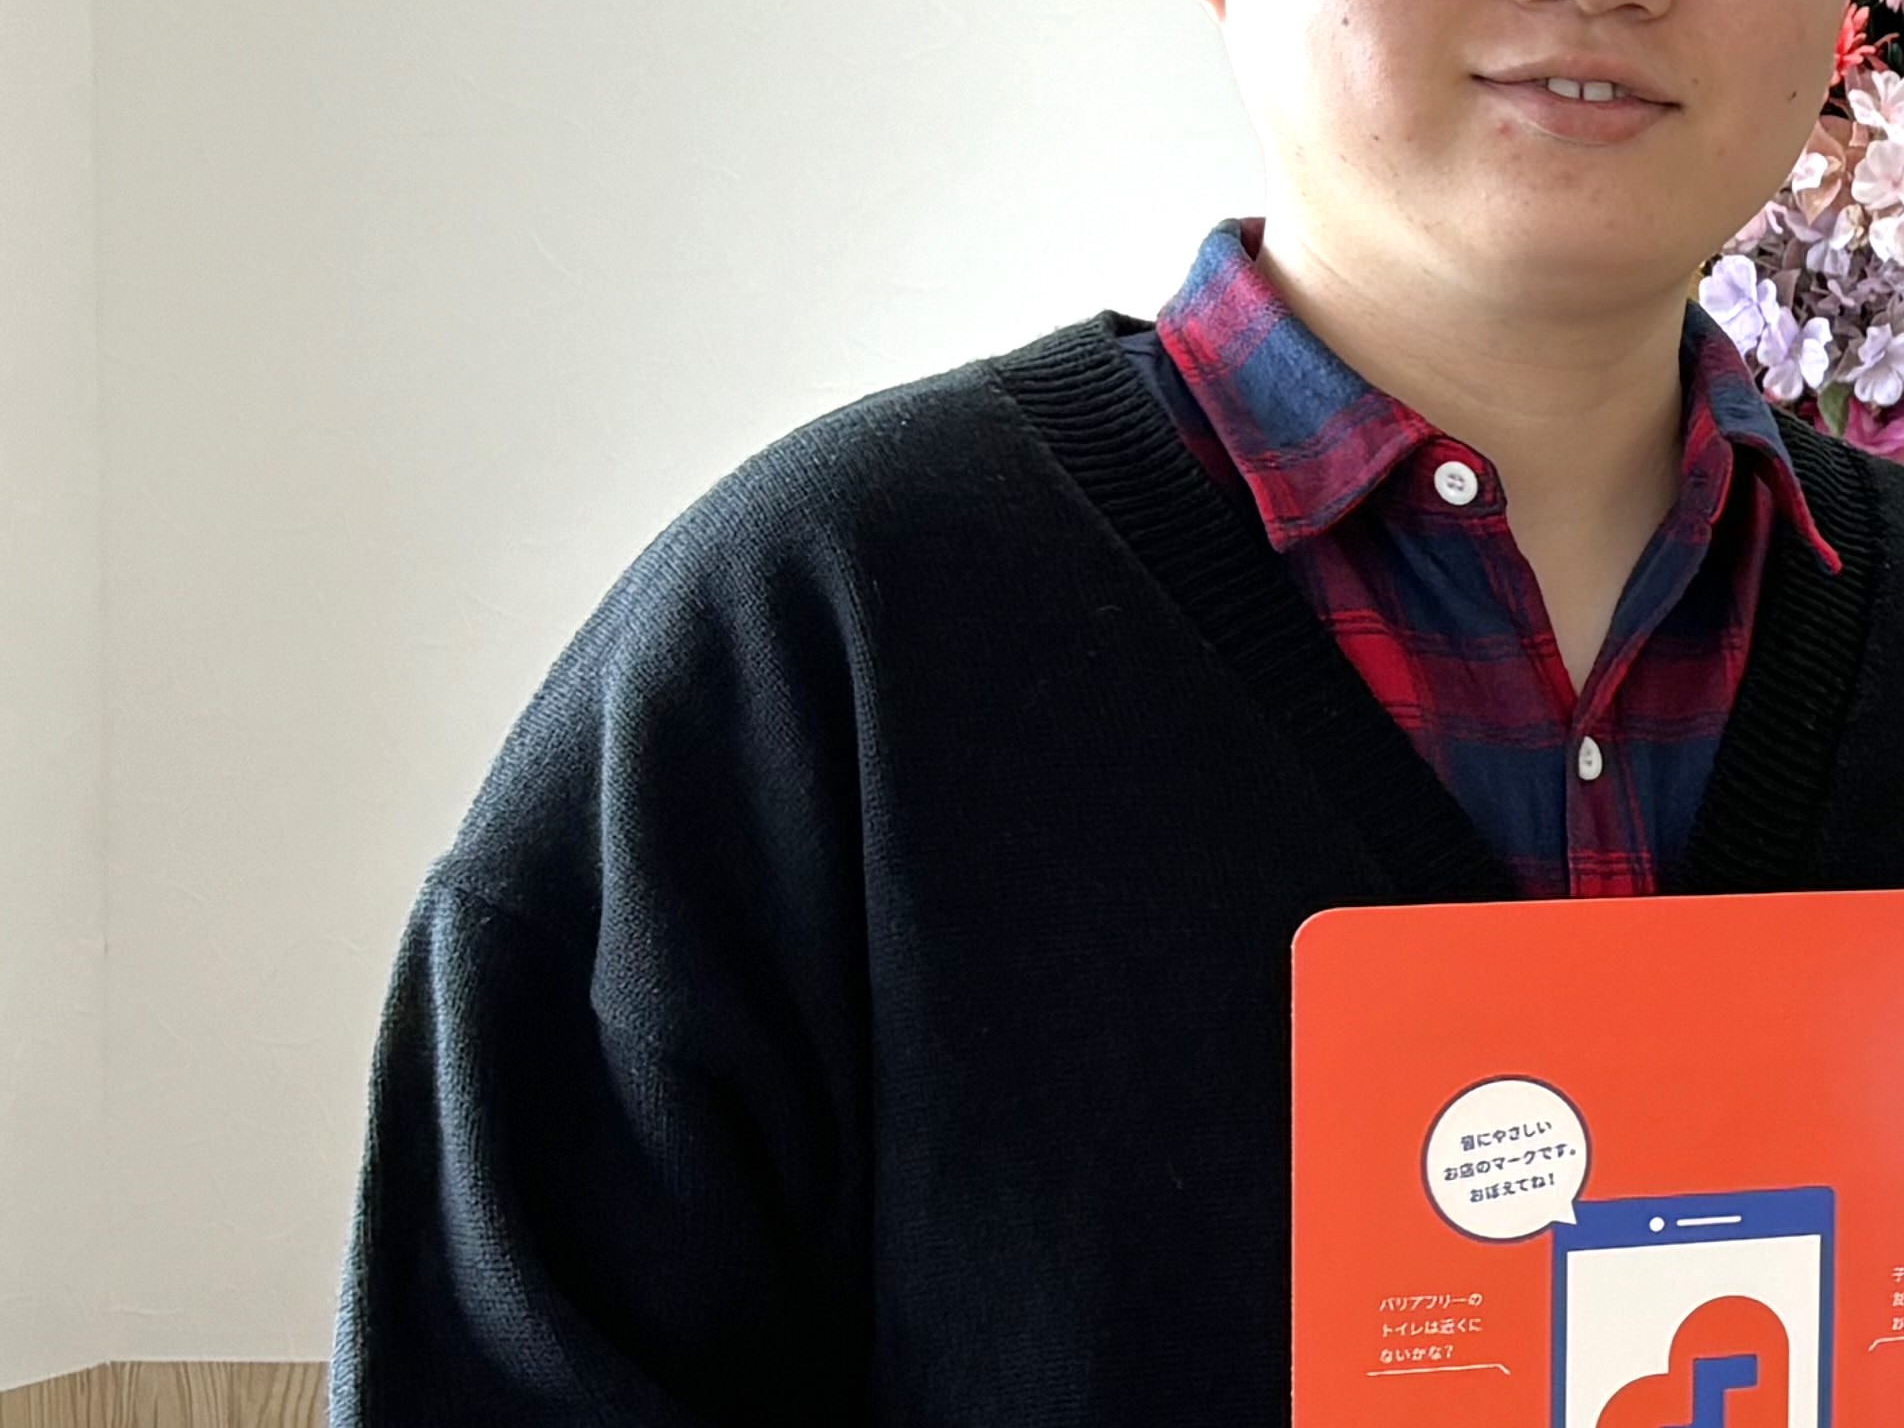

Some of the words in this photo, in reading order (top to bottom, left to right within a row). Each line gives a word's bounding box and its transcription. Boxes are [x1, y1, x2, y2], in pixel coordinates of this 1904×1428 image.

[1444, 1144, 1576, 1181] お店のマークです。
[1379, 1293, 1483, 1312] バリアフリーの
[1382, 1318, 1483, 1337] トイレは近くに
